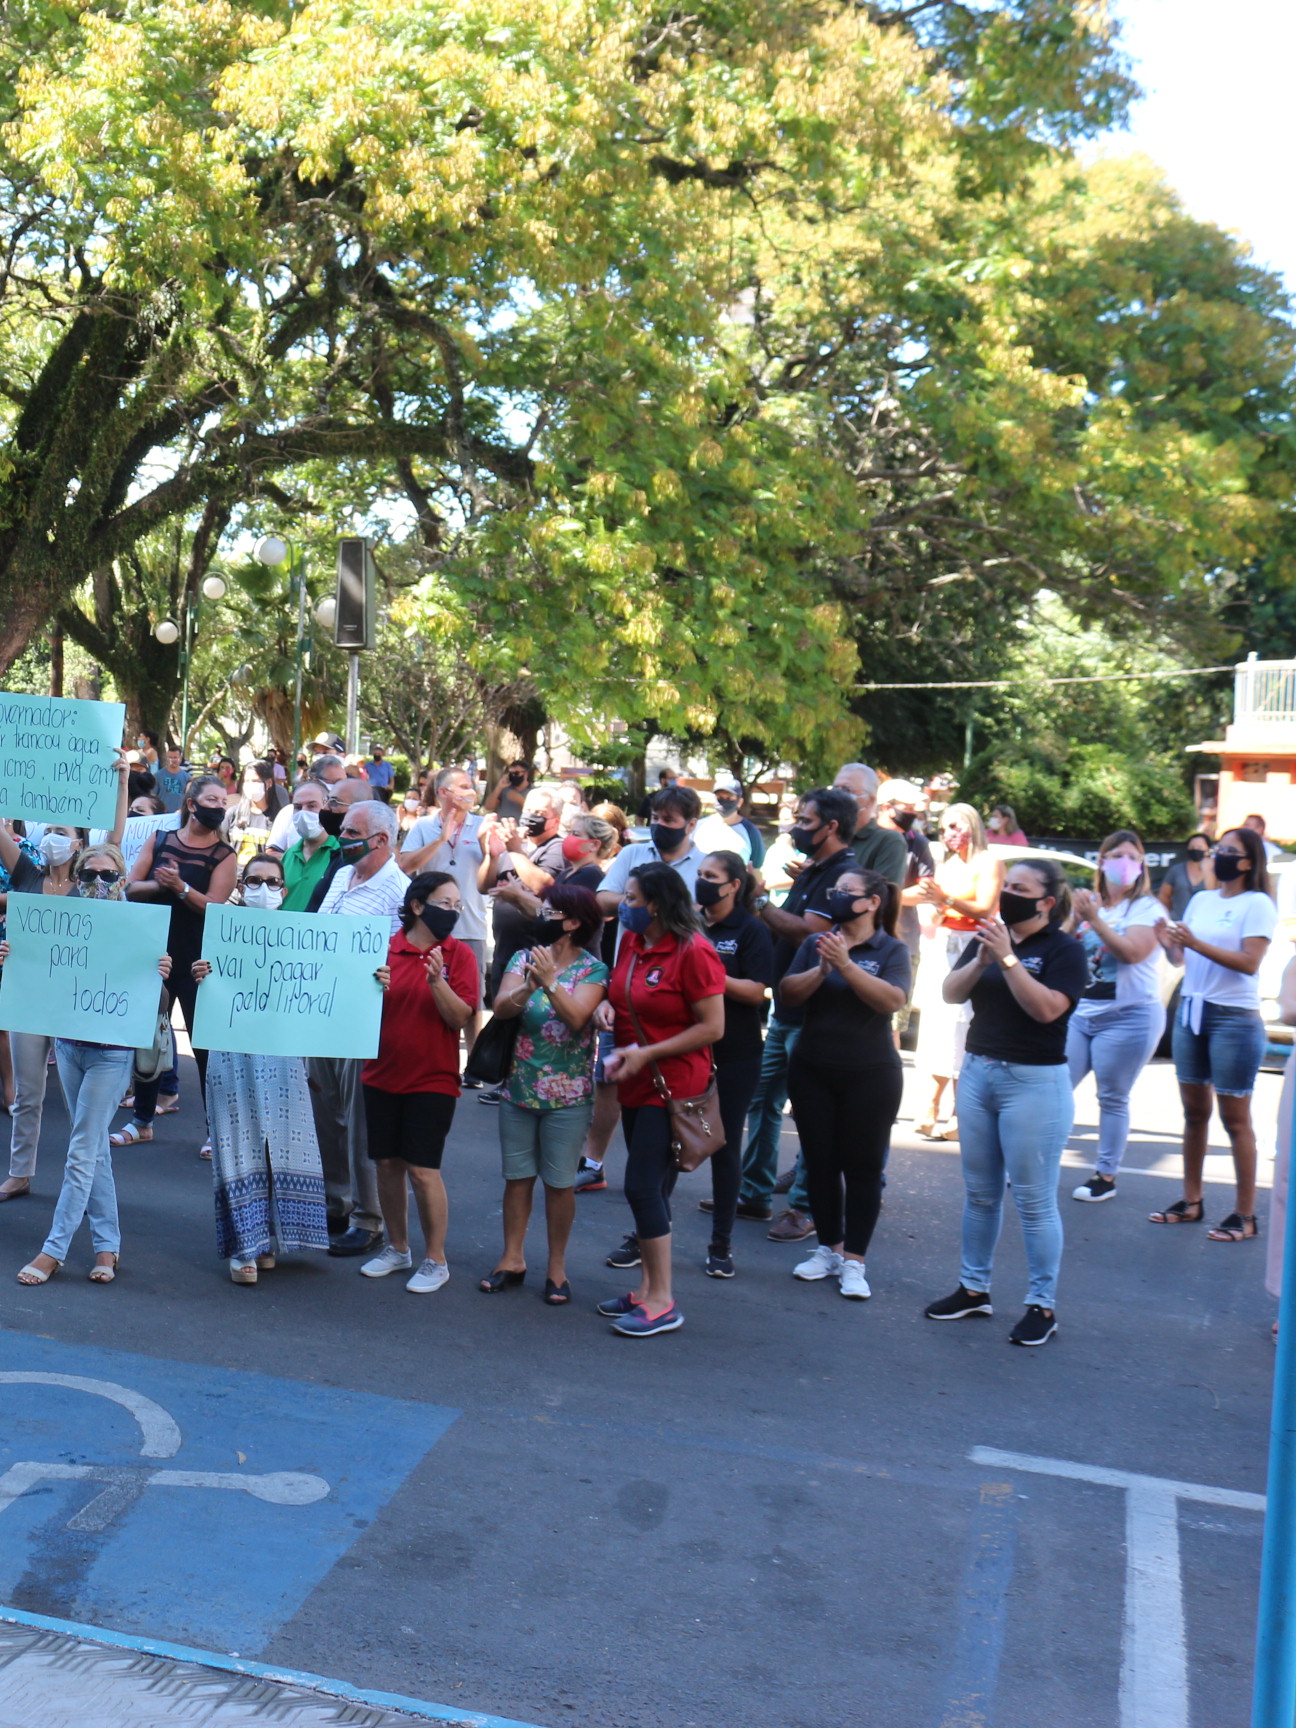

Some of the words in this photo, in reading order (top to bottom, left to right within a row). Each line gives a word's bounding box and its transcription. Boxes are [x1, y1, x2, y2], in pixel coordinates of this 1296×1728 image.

[49, 943, 88, 978] para
[220, 914, 339, 968] Uruguaiana
[351, 923, 383, 954] não
[73, 972, 129, 1017] todos
[267, 960, 324, 998] pagar
[229, 978, 269, 1028] pelo
[275, 976, 338, 1017] litoral
